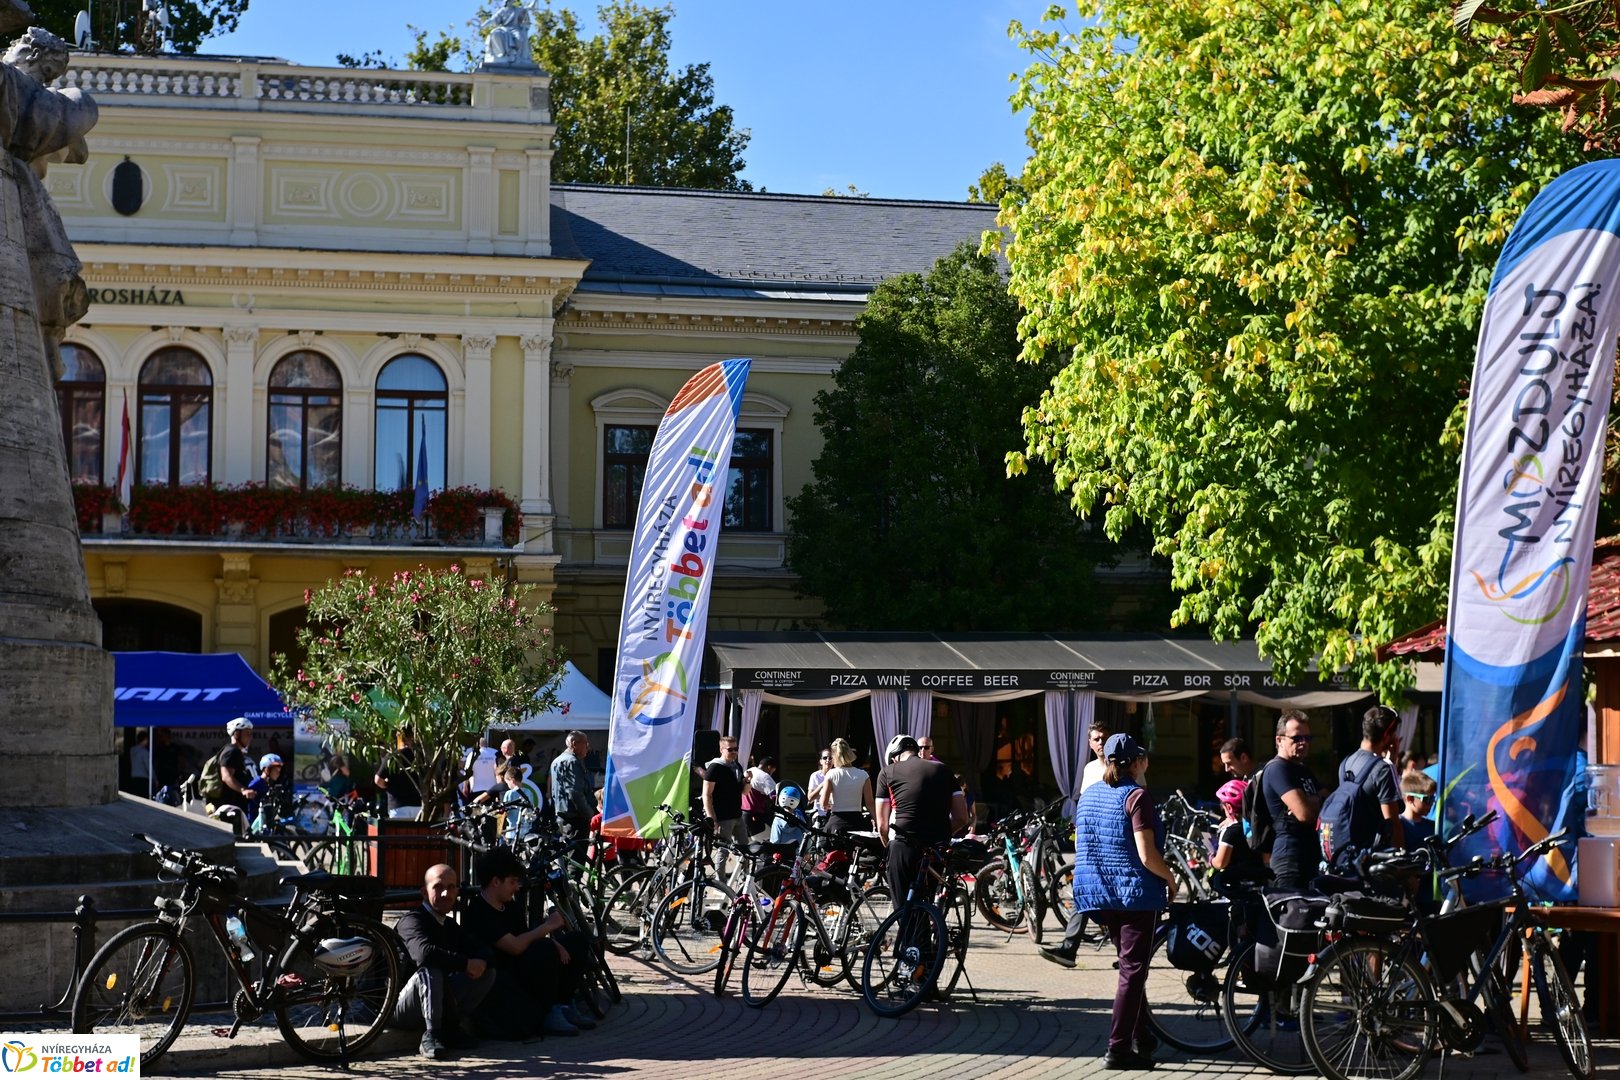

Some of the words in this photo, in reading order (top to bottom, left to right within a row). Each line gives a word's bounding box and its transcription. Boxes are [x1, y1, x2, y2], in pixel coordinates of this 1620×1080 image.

[665, 515, 709, 644] Többet
[688, 446, 719, 509] ad!
[643, 495, 678, 641] NYÍREGYHÁZA
[754, 671, 802, 679] CONTINENT
[830, 675, 868, 686] PIZZA
[877, 675, 911, 686] WINE
[921, 675, 973, 687] COFFEE
[983, 675, 1019, 687] BEER
[1050, 672, 1096, 680] CONTINENT
[1132, 675, 1169, 687] PIZZA
[1184, 675, 1211, 687] BOR
[1223, 673, 1250, 687] SÖR
